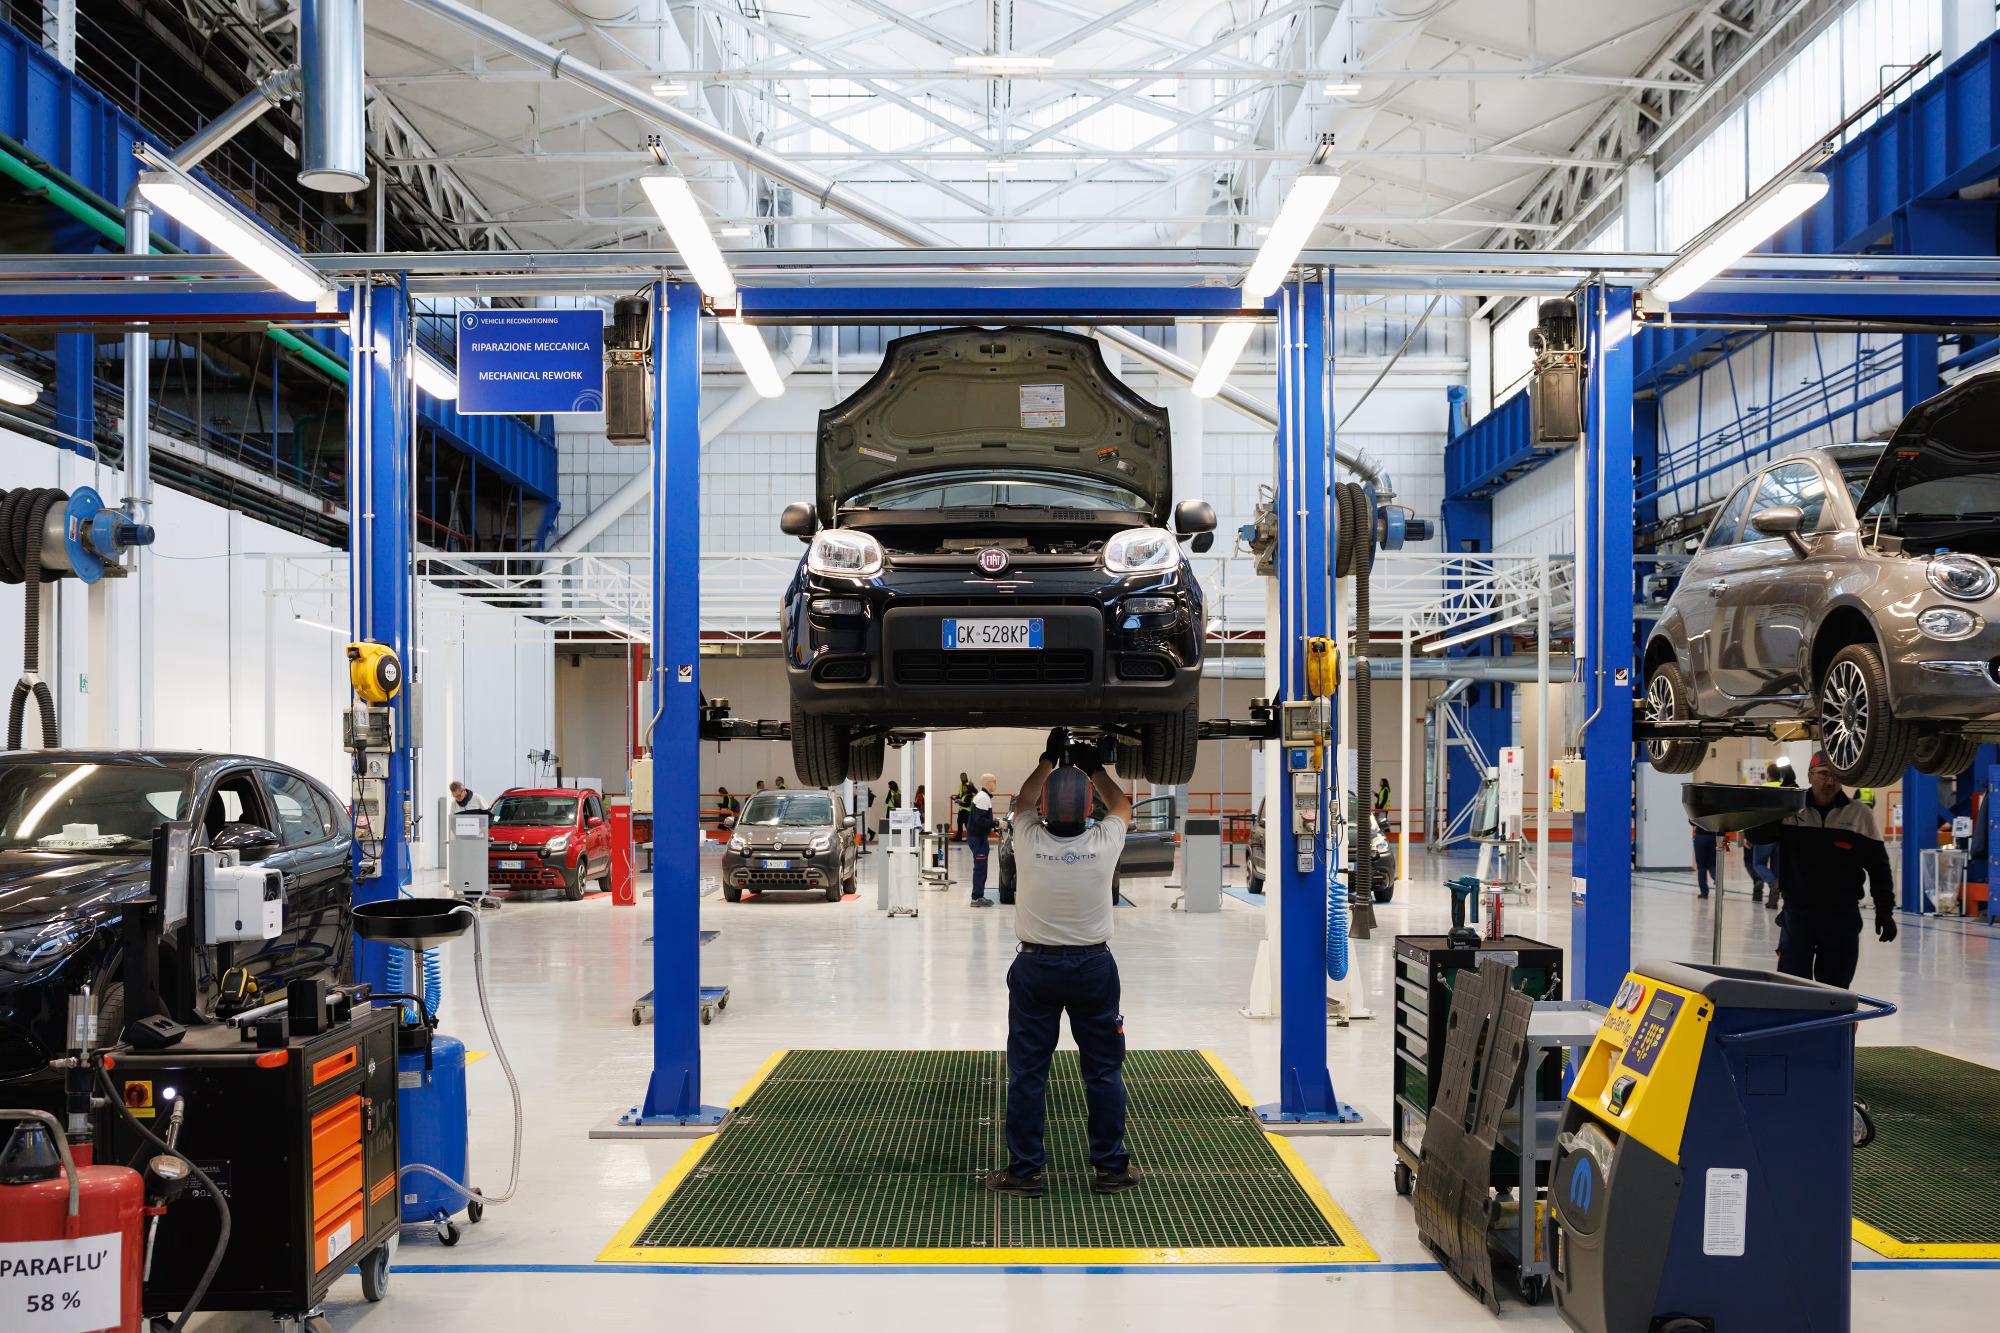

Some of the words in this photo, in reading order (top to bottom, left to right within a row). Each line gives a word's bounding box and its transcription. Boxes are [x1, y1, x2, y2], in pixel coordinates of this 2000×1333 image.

[506, 317, 559, 325] RECONDITIONING
[471, 342, 532, 352] RIPARAZIONE
[534, 341, 590, 351] MECCANICA
[479, 371, 540, 381] MECHANICAL
[542, 371, 583, 380] REWORK
[986, 554, 1001, 567] FIAT
[1035, 852, 1097, 862] STELLANTIS
[26, 1293, 55, 1313] 58
[61, 1290, 81, 1310] %
